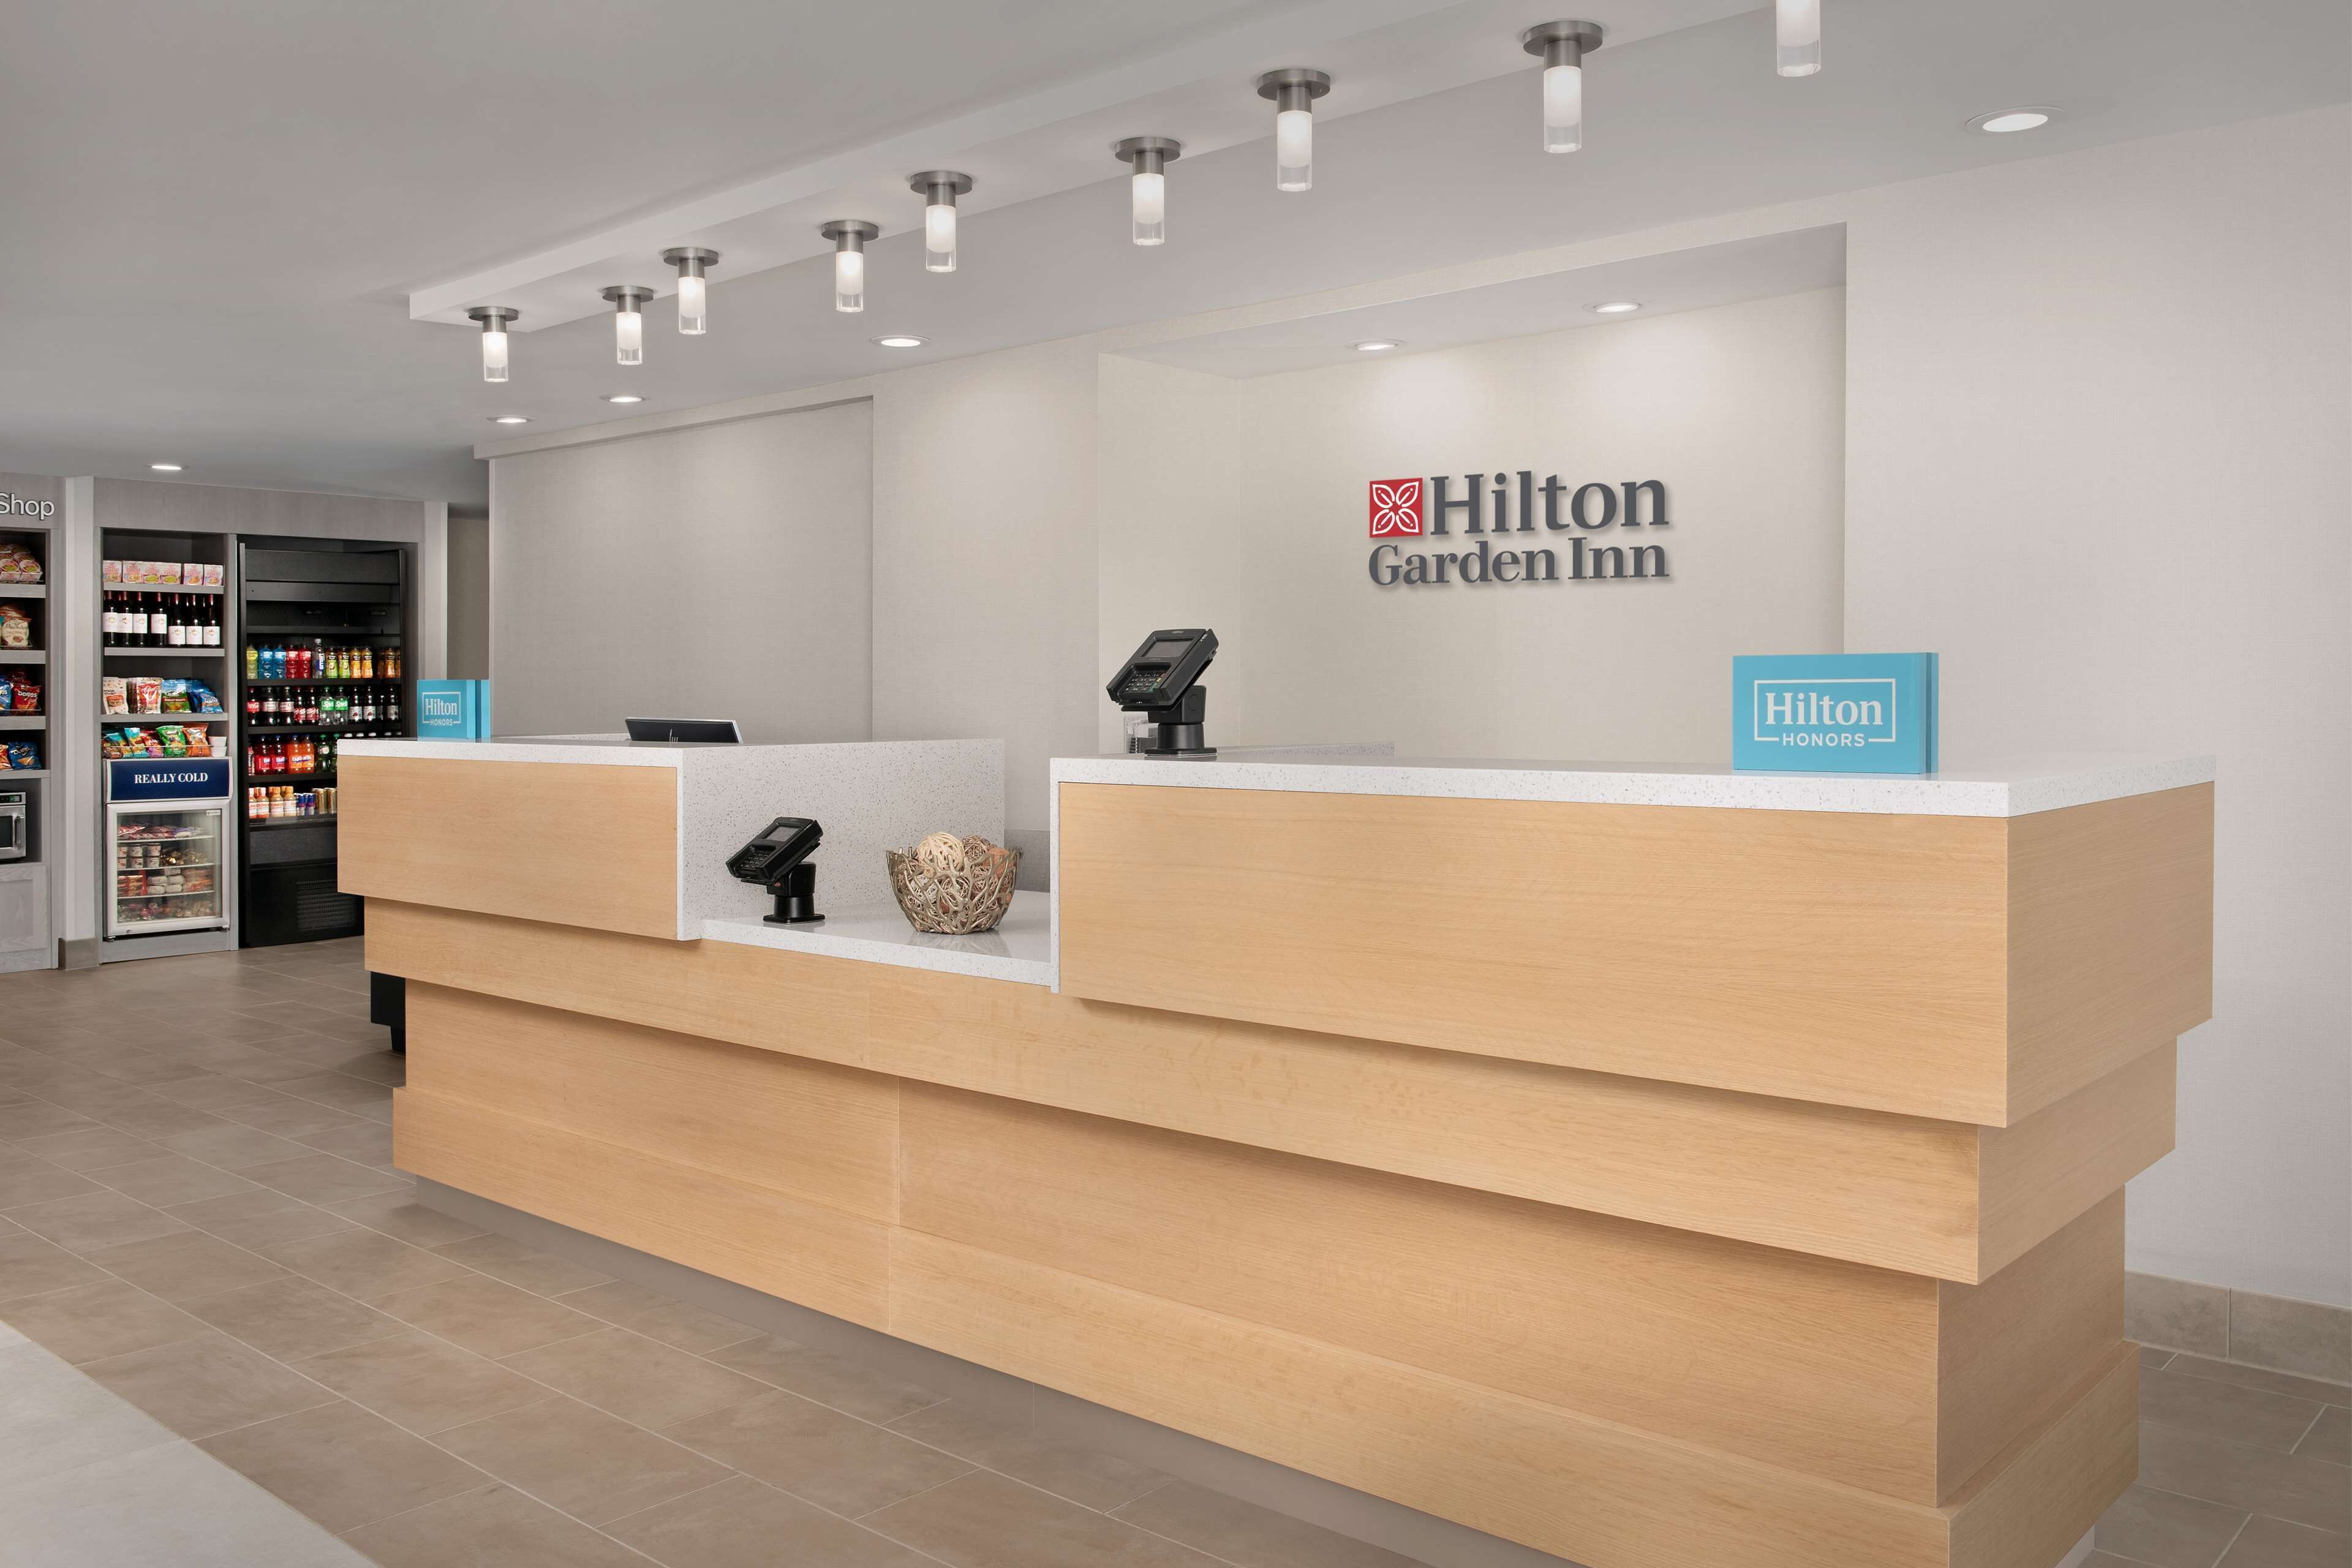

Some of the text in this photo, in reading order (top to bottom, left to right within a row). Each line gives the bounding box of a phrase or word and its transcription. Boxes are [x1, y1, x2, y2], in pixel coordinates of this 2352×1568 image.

[0, 492, 55, 521] Shop
[1430, 470, 1669, 535] Hilton
[1368, 537, 1670, 586] Garden Inn
[425, 698, 458, 715] Hilton
[1765, 693, 1883, 725] Hilton
[1782, 733, 1865, 747] HONORS
[134, 772, 208, 784] REALLY COLD
